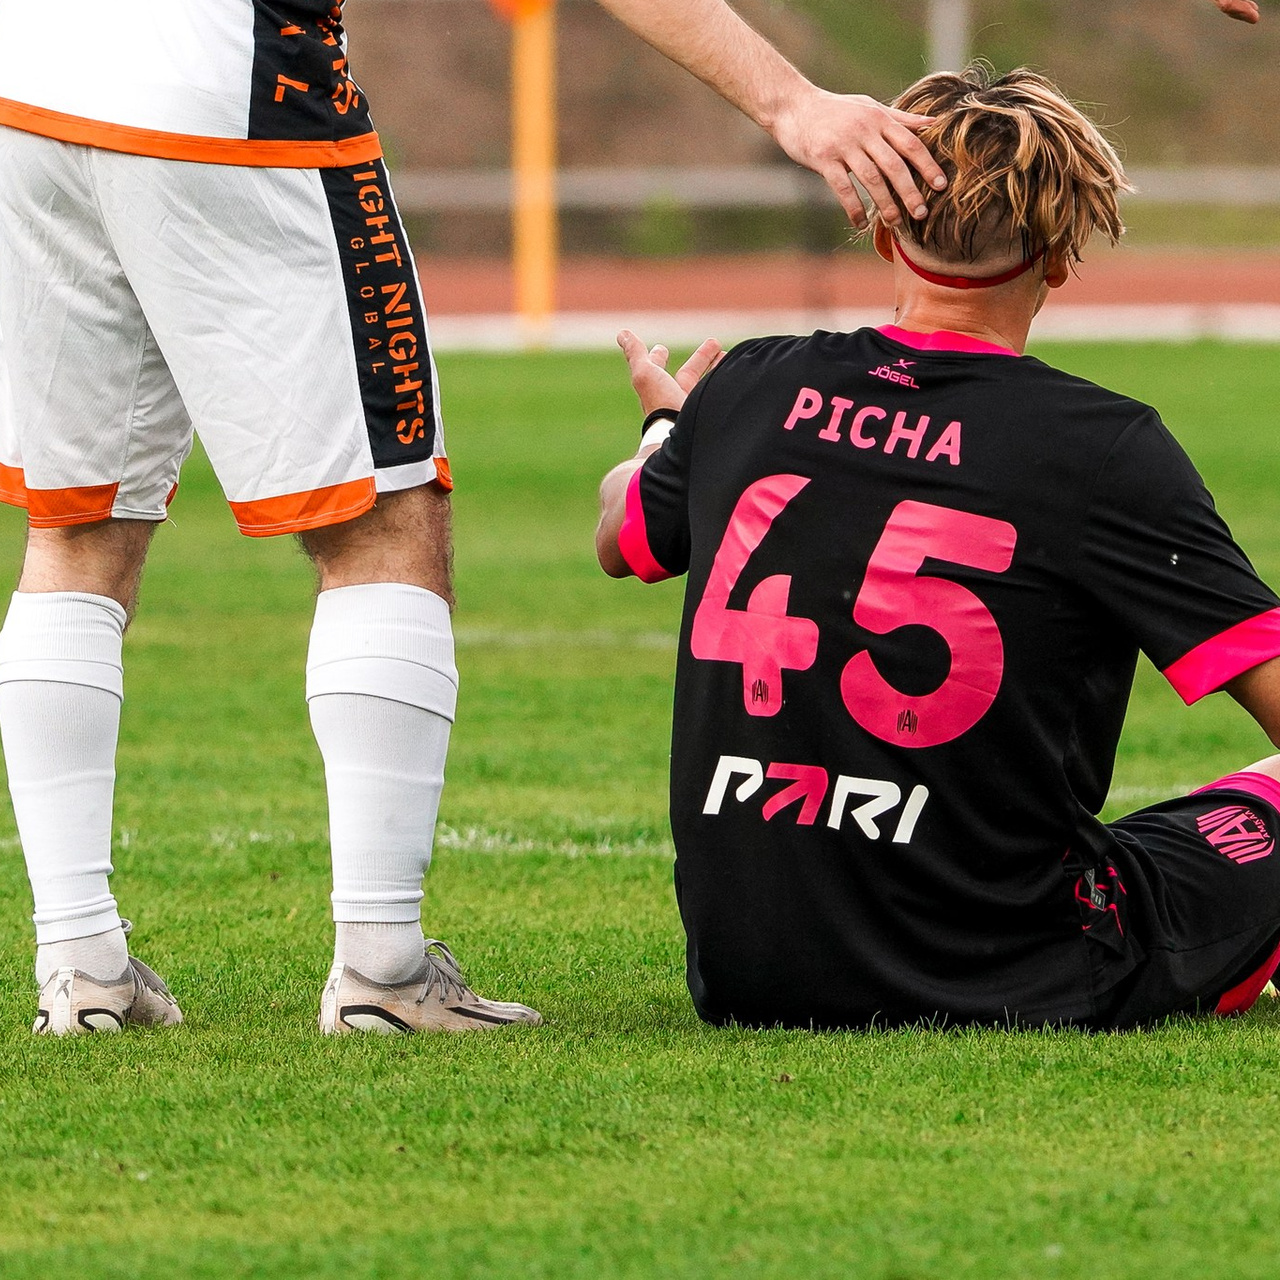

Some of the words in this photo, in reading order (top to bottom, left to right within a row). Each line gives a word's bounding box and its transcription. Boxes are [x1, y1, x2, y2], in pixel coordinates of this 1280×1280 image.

[350, 235, 387, 374] GLOBAL
[380, 281, 426, 446] NIGHTS
[868, 365, 920, 389] JÖGEL
[783, 387, 962, 466] PICHA
[690, 473, 1018, 749] 45
[702, 755, 929, 844] PARI
